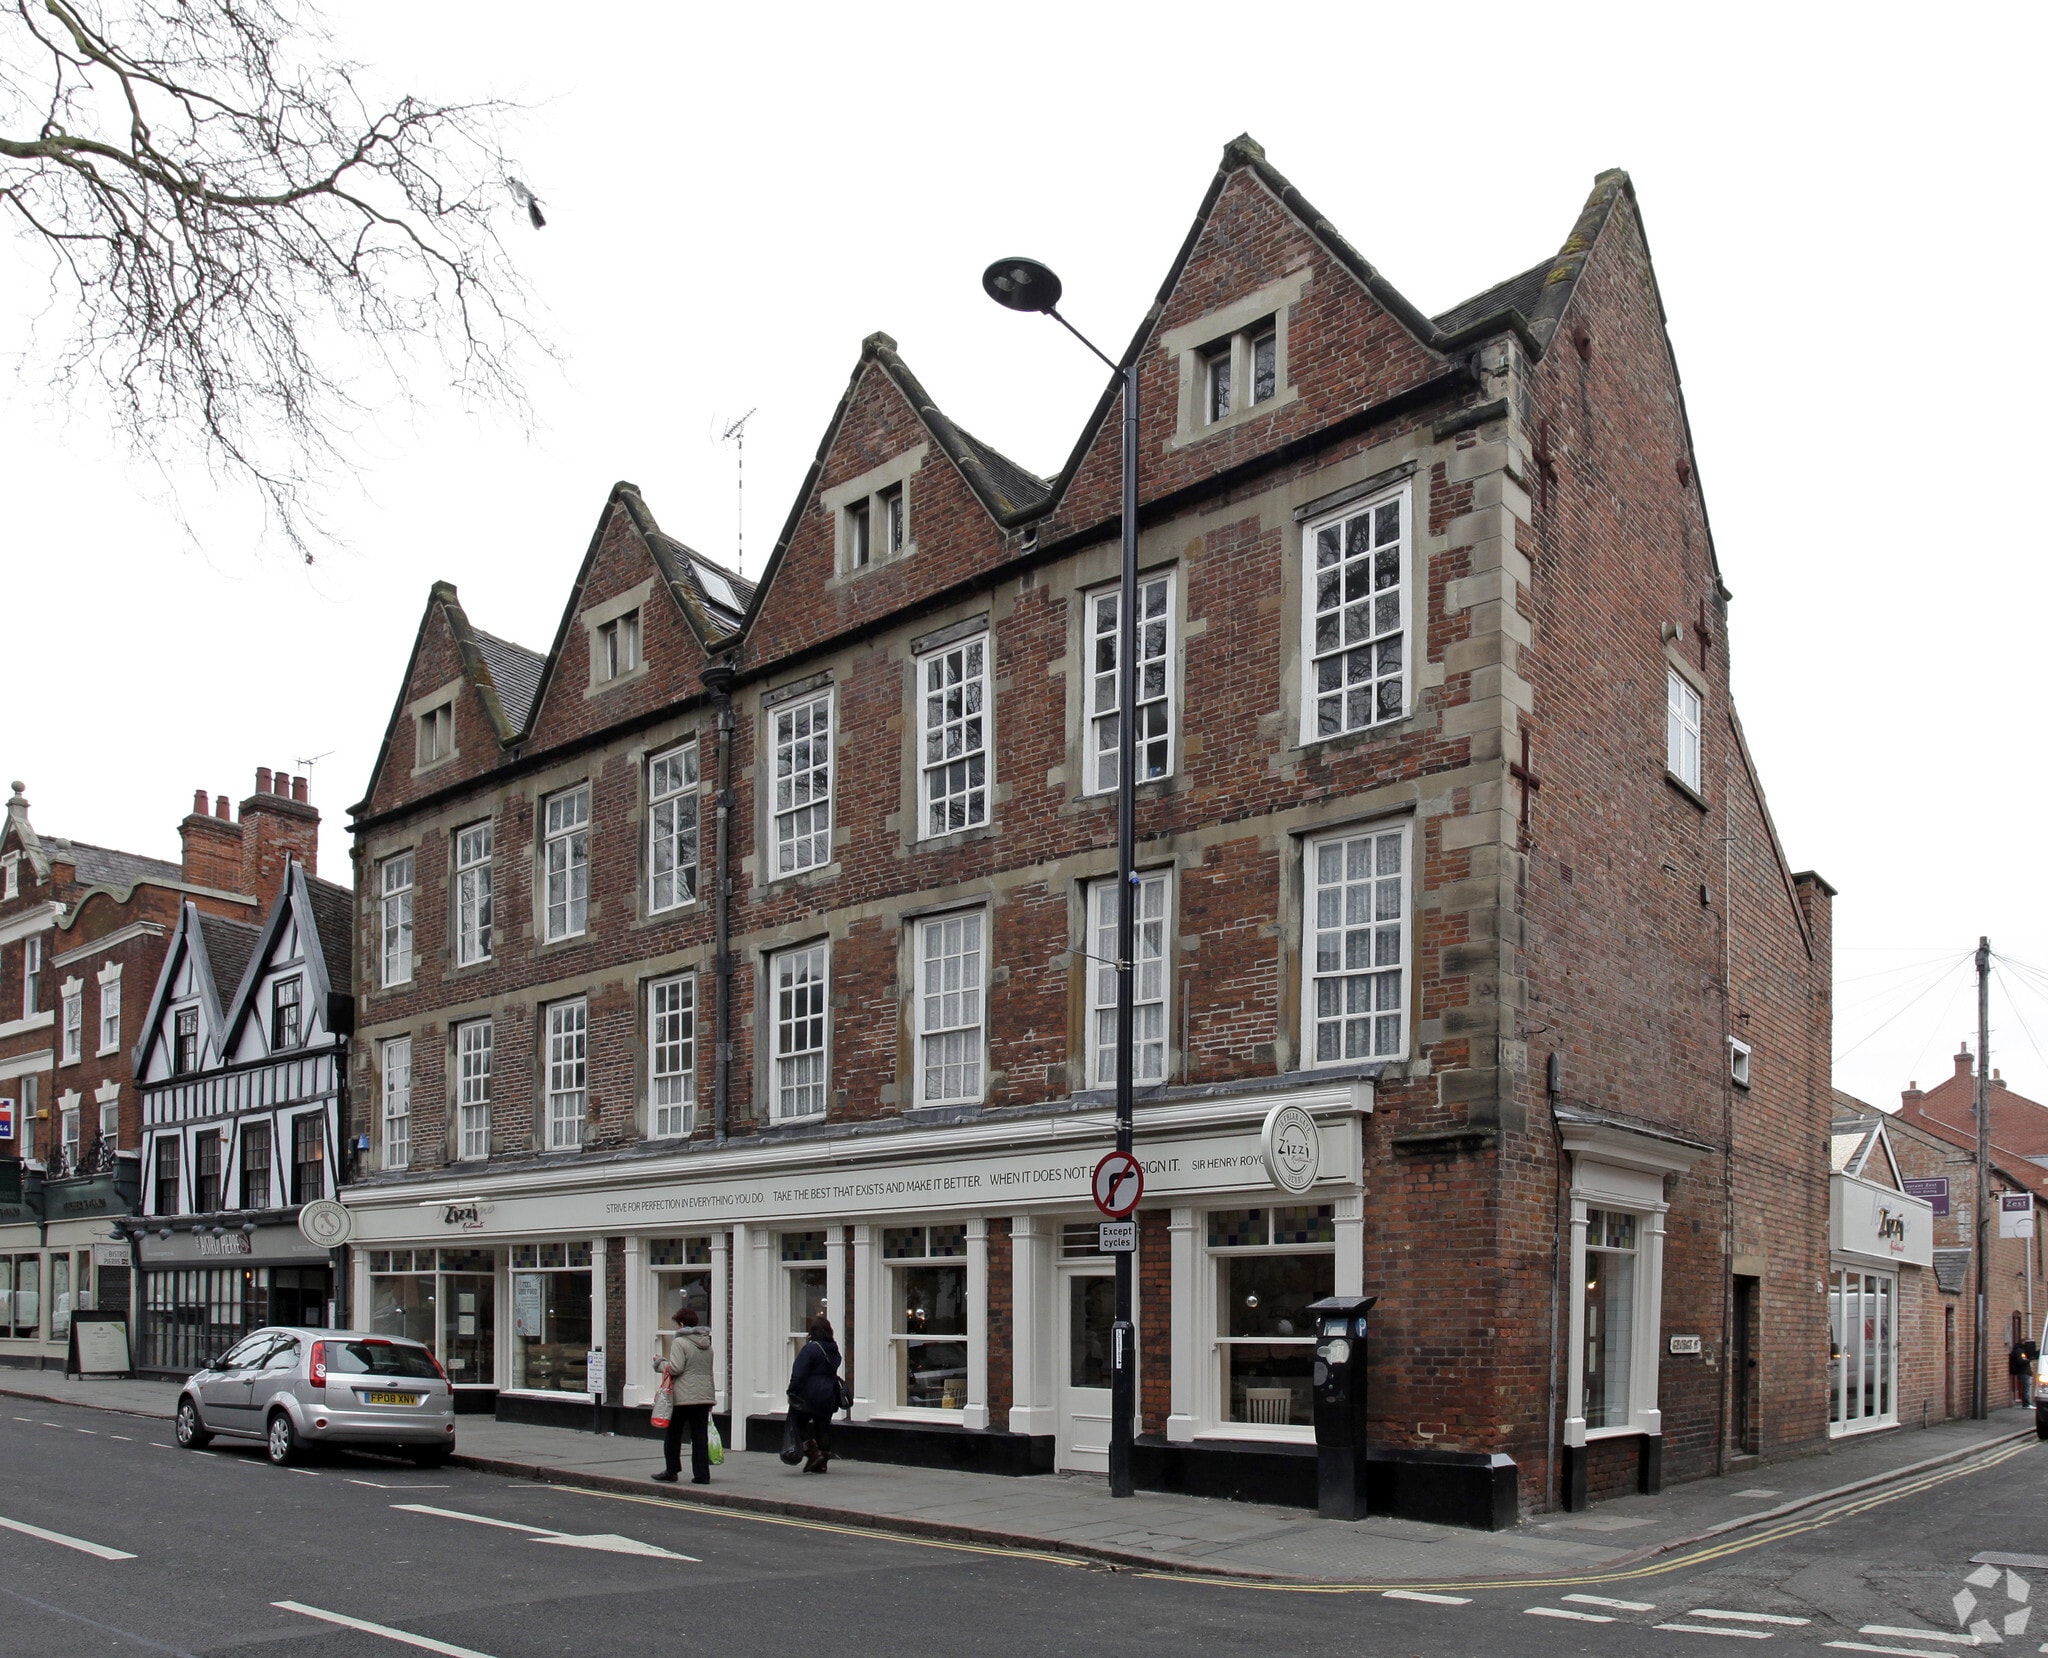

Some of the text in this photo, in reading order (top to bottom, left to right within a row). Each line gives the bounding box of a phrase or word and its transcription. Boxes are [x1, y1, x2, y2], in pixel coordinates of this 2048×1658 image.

[1278, 1138, 1309, 1159] Zizzi
[606, 1202, 627, 1214] STRIVE
[628, 1202, 641, 1212] FOR
[641, 1199, 681, 1211] PERFECTION
[681, 1198, 689, 1208] IN
[689, 1195, 734, 1208] EVERYTHING
[734, 1193, 750, 1204] YOU
[752, 1192, 765, 1203] DO.
[773, 1190, 792, 1201] TAKE
[793, 1189, 809, 1200] THE
[811, 1187, 831, 1199] BEST
[833, 1185, 854, 1198] THAT
[855, 1183, 885, 1196] EXISTS
[886, 1181, 905, 1194] AND
[906, 1179, 932, 1191] MAKE
[933, 1178, 942, 1190] IT
[944, 1175, 982, 1190] BETTER.
[990, 1169, 1020, 1185] WHEN
[1021, 1169, 1031, 1183] IT
[1033, 1168, 1062, 1182] DOES
[1064, 1166, 1087, 1180] NOT
[1140, 1160, 1166, 1174] SIGN
[1168, 1158, 1180, 1172] IT.
[1191, 1159, 1206, 1170] SIR
[1207, 1157, 1238, 1169] HENRY
[1240, 1154, 1265, 1166] ROYC
[1287, 1174, 1305, 1184] DERBY
[2006, 1200, 2026, 1208] Zest
[444, 1203, 478, 1224] Zizzi
[1102, 1226, 1132, 1236] Except
[1103, 1238, 1130, 1248] cycles
[370, 1394, 416, 1404] FP08 XNV
